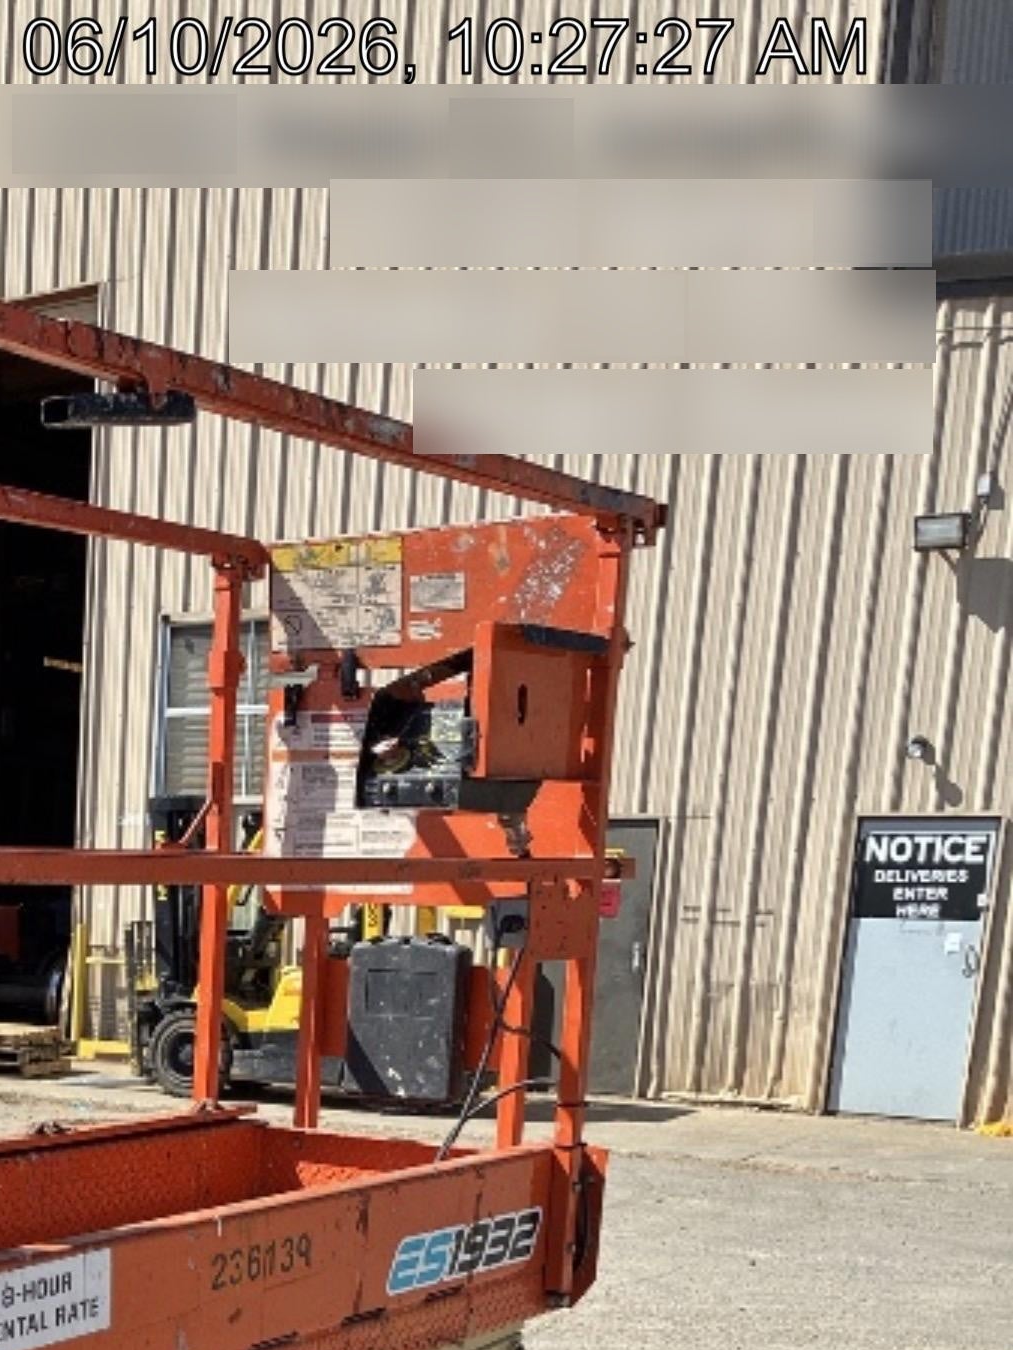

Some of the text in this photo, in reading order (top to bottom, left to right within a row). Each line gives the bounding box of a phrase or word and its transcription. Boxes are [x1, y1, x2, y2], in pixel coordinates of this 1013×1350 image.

[865, 835, 987, 863] NOTICE
[874, 869, 969, 883] DELIVERIES
[892, 886, 948, 901] ENTER
[895, 903, 940, 919] HERE
[388, 1208, 539, 1293] ES1932
[1, 1270, 73, 1309] 8-HOUR
[55, 1295, 100, 1328] RATE
